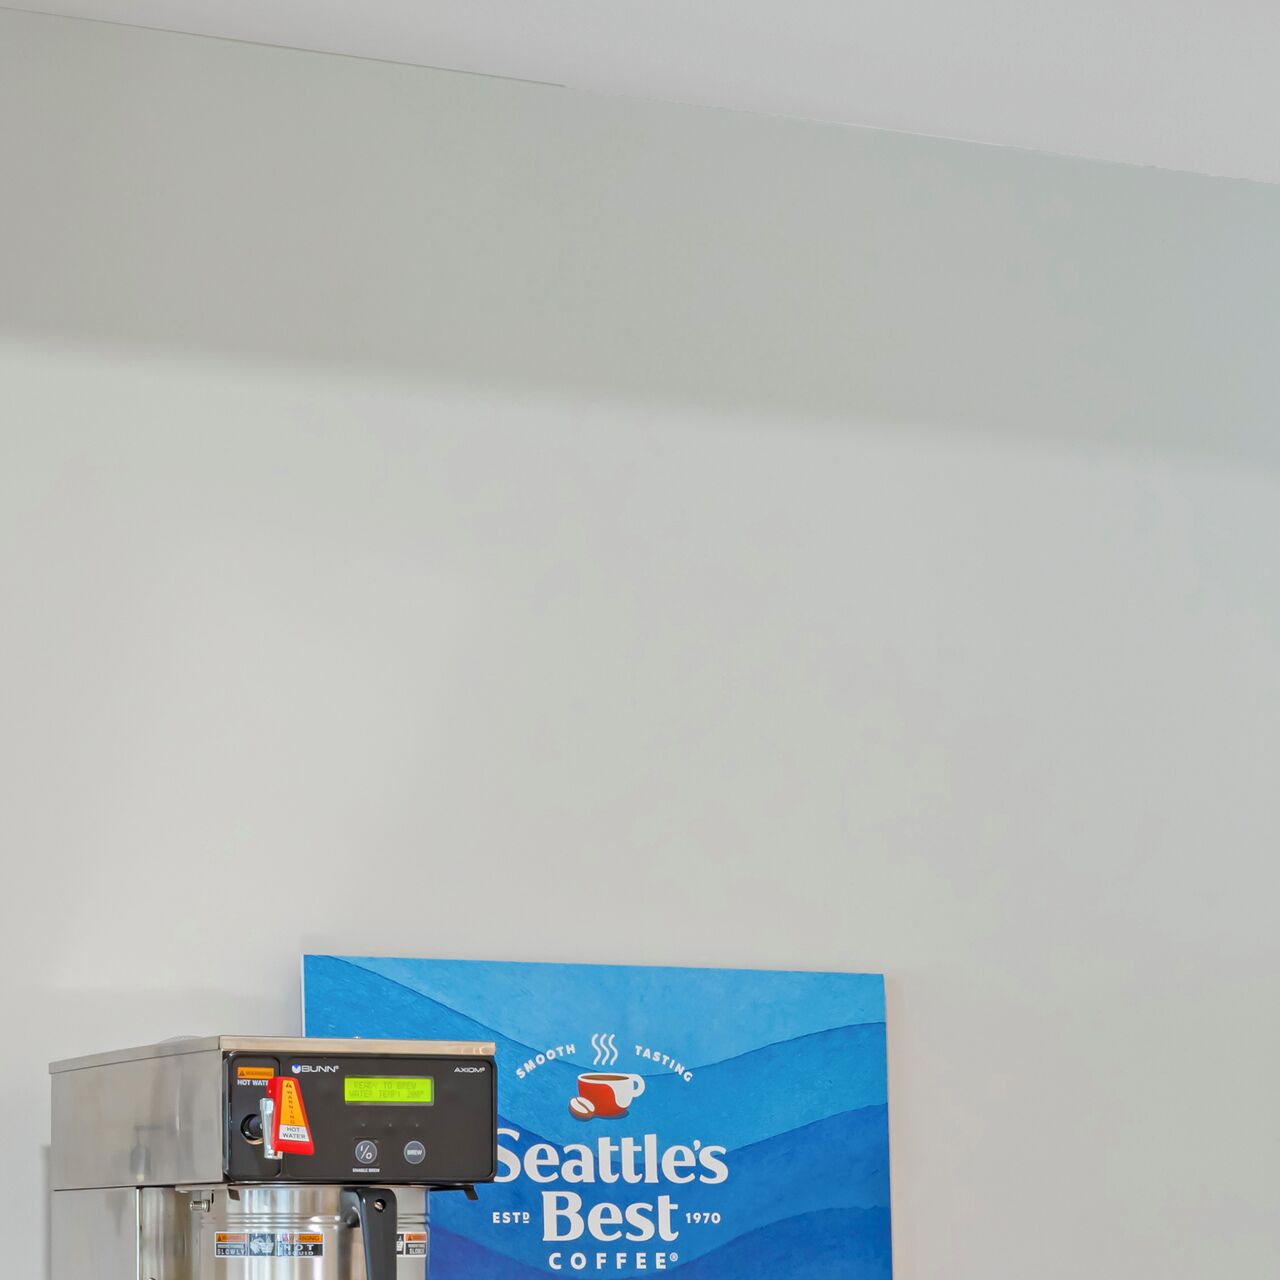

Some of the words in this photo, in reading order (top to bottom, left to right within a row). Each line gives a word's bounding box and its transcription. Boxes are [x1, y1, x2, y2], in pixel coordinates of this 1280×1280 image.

[516, 1043, 576, 1079] SMOOTH
[634, 1044, 693, 1082] TASTING
[494, 1128, 729, 1185] Seattle's
[542, 1190, 679, 1242] Best
[685, 1212, 721, 1224] 1970
